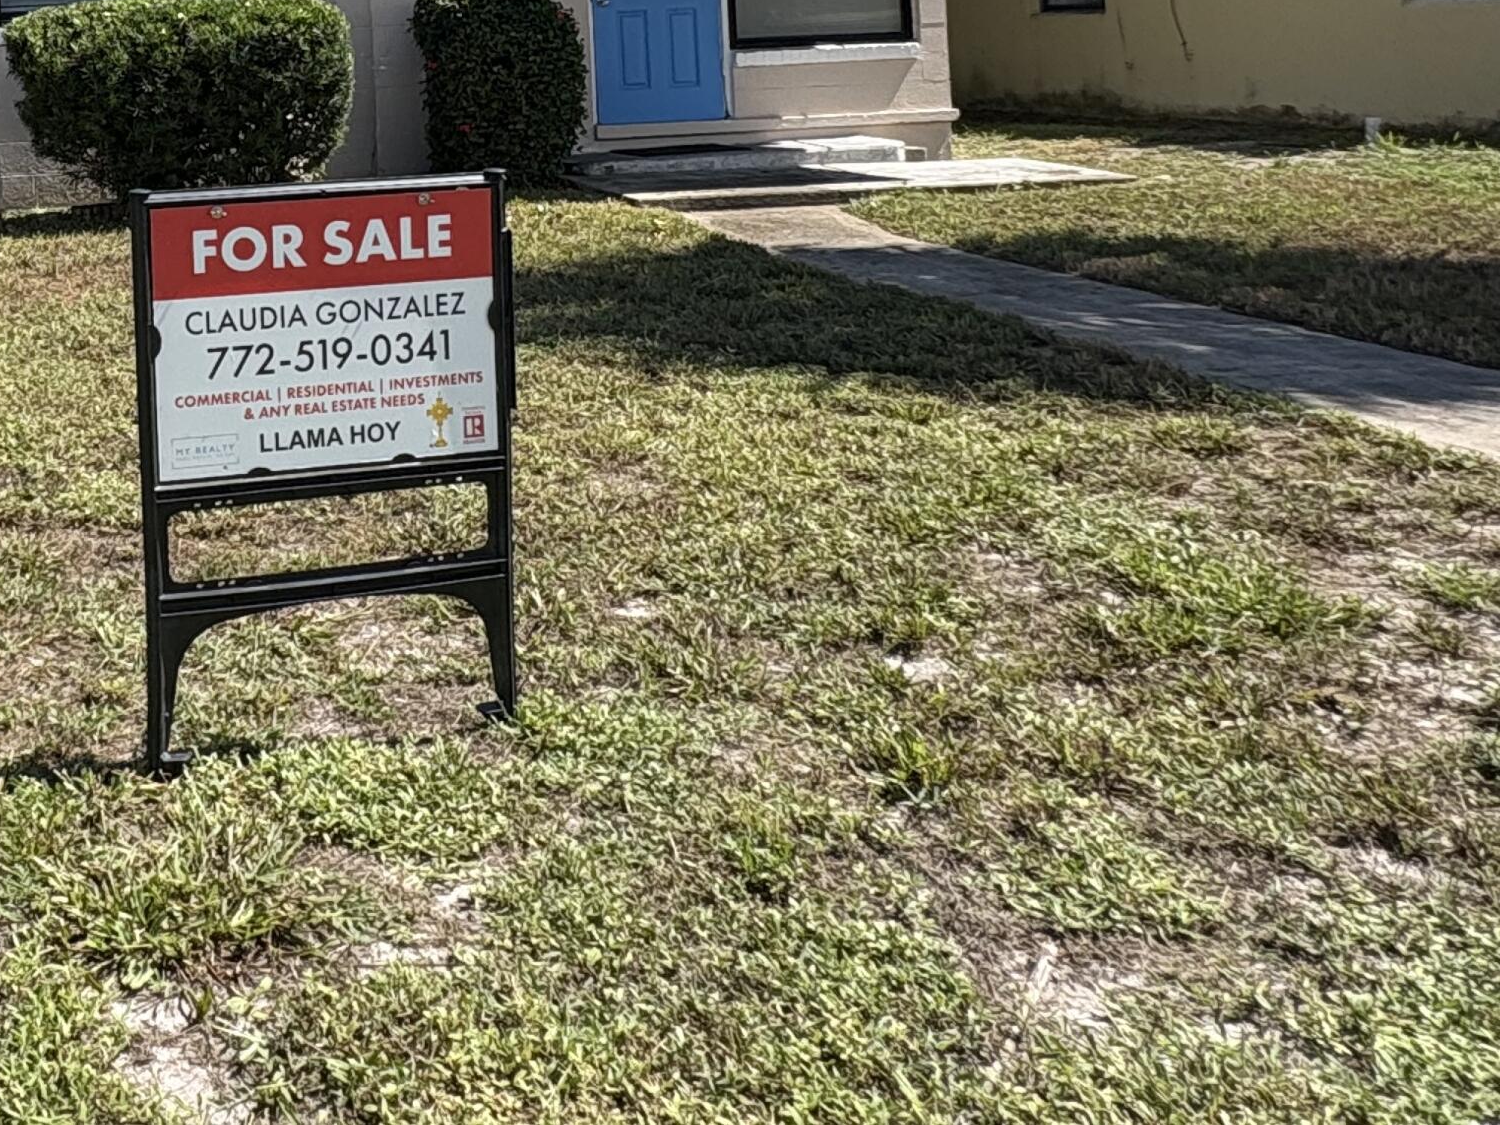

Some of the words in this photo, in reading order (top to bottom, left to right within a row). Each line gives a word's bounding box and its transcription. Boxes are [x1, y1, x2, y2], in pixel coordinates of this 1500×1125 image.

[192, 225, 307, 275] FOR
[323, 214, 452, 266] SALE
[185, 304, 308, 335] CLAUDIA
[315, 292, 466, 325] GONZALEZ
[207, 329, 450, 380] 772-519-0341
[174, 388, 273, 409] COMMERCIAL
[286, 380, 375, 399] RESIDENTIAL
[389, 371, 484, 391] INVESTMENTS
[243, 407, 255, 420] &
[259, 404, 291, 419] ANY
[294, 402, 328, 416] REAL
[331, 397, 381, 412] ESTATE
[381, 393, 425, 408] NEEDS
[260, 427, 344, 453] LLAMA
[350, 421, 401, 445] HOY
